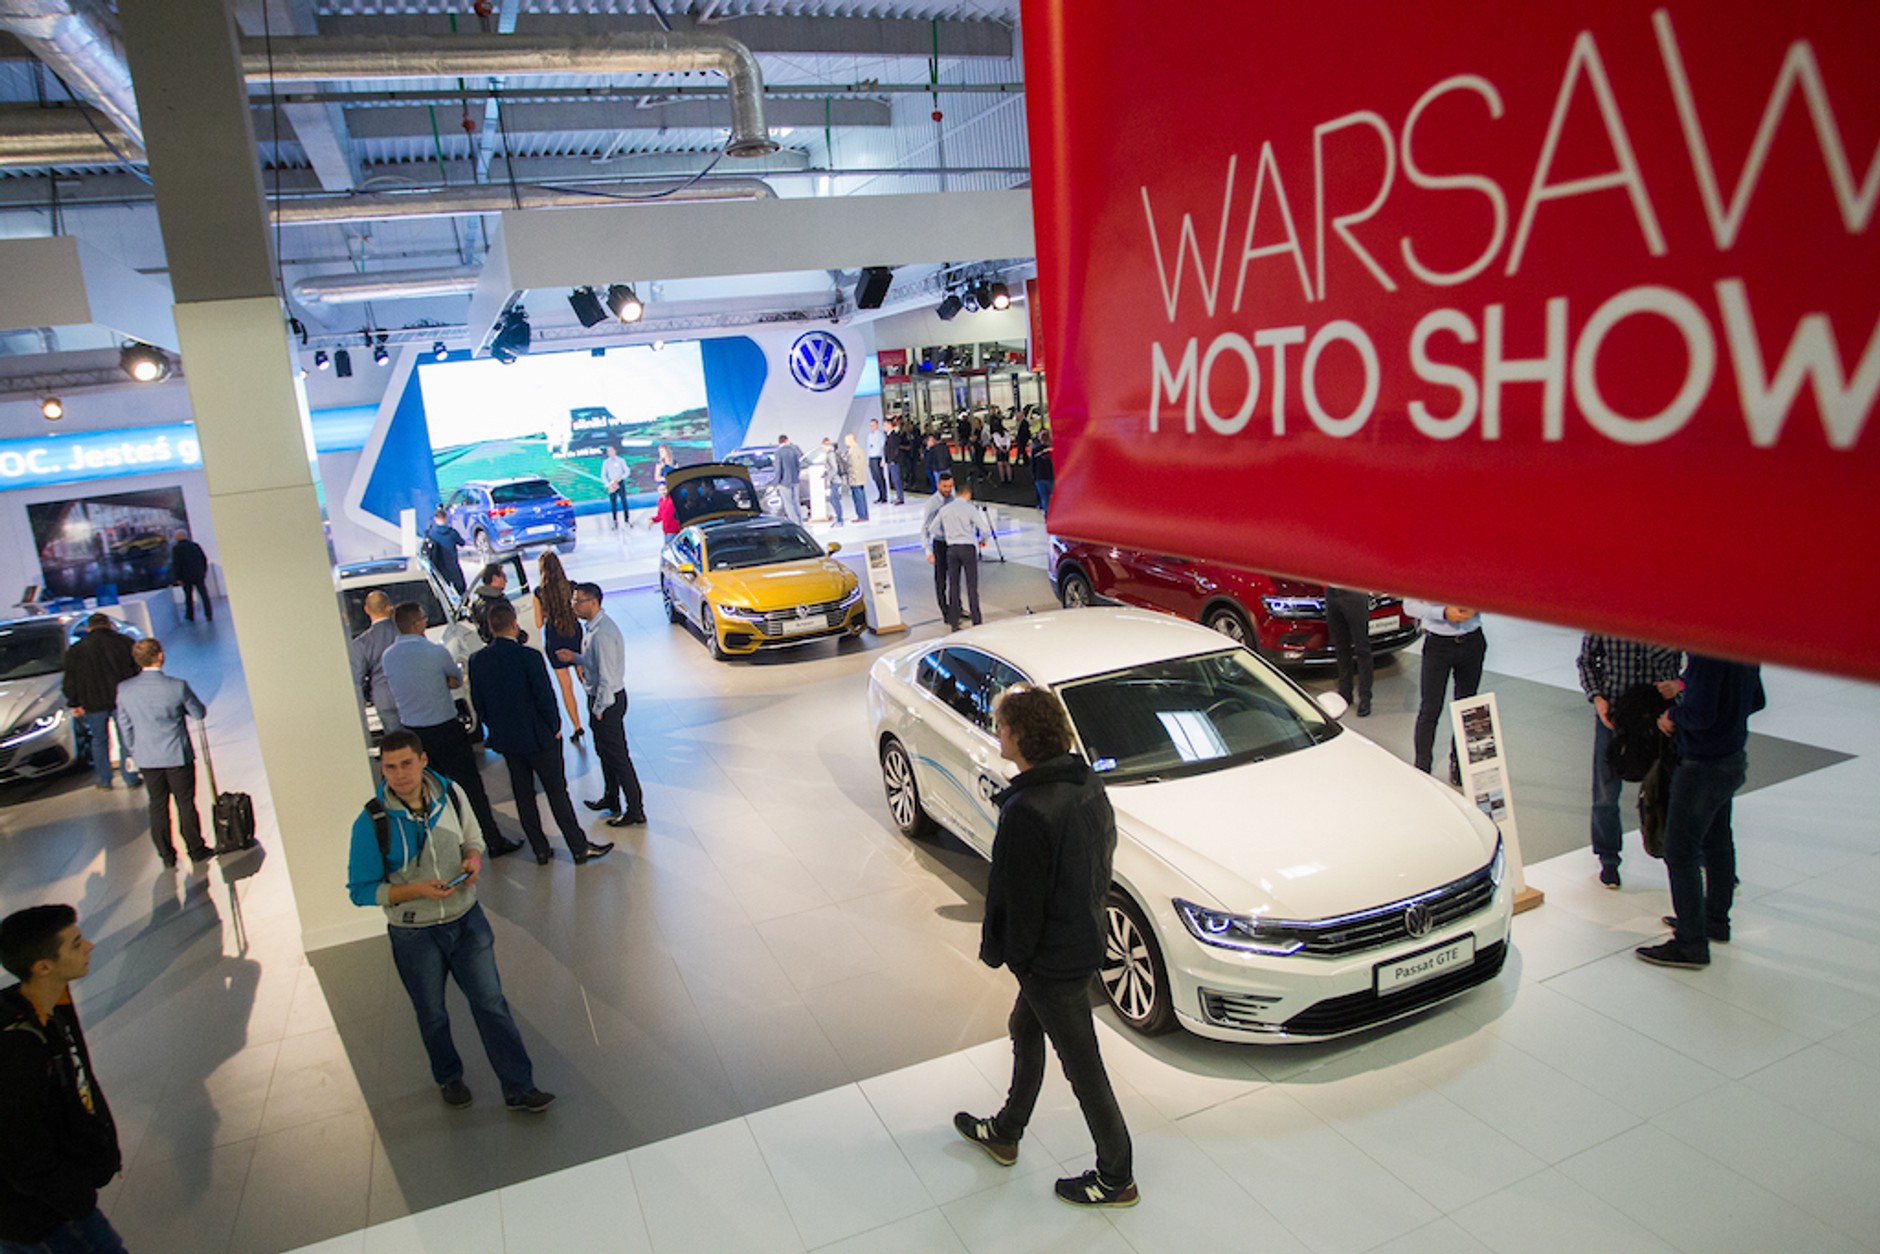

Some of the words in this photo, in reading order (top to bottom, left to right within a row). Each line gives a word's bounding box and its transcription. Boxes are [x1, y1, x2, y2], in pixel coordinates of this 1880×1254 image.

[1140, 7, 1880, 323] WARSAW
[1149, 319, 1380, 438] MOTO
[1407, 276, 1880, 451] SHOW
[67, 435, 172, 470] Jesteś
[1394, 958, 1434, 980] Passat
[1435, 947, 1460, 966] GTE
[976, 1123, 989, 1140] N
[1085, 1185, 1105, 1201] N
